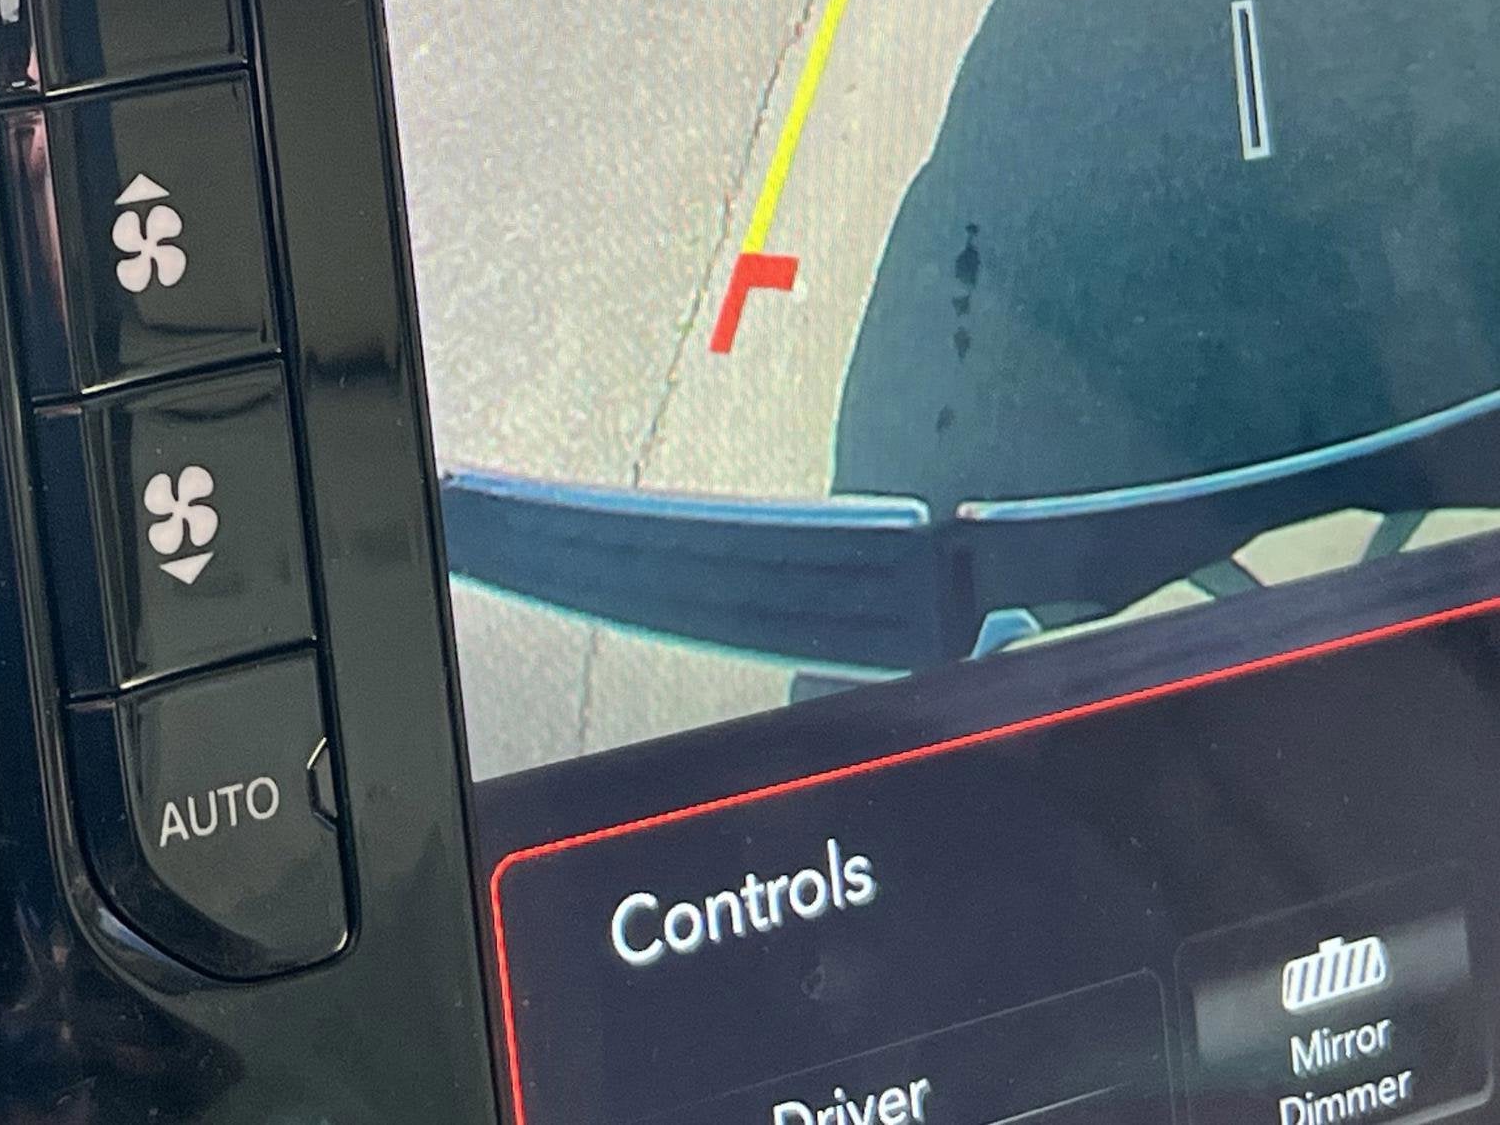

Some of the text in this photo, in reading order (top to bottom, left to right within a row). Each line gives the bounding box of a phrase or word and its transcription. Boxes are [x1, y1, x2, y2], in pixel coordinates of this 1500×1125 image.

[159, 776, 280, 848] AUTO
[611, 838, 877, 965] Controls
[1290, 1019, 1393, 1075] Mirror
[1279, 1070, 1412, 1125] Dimmer
